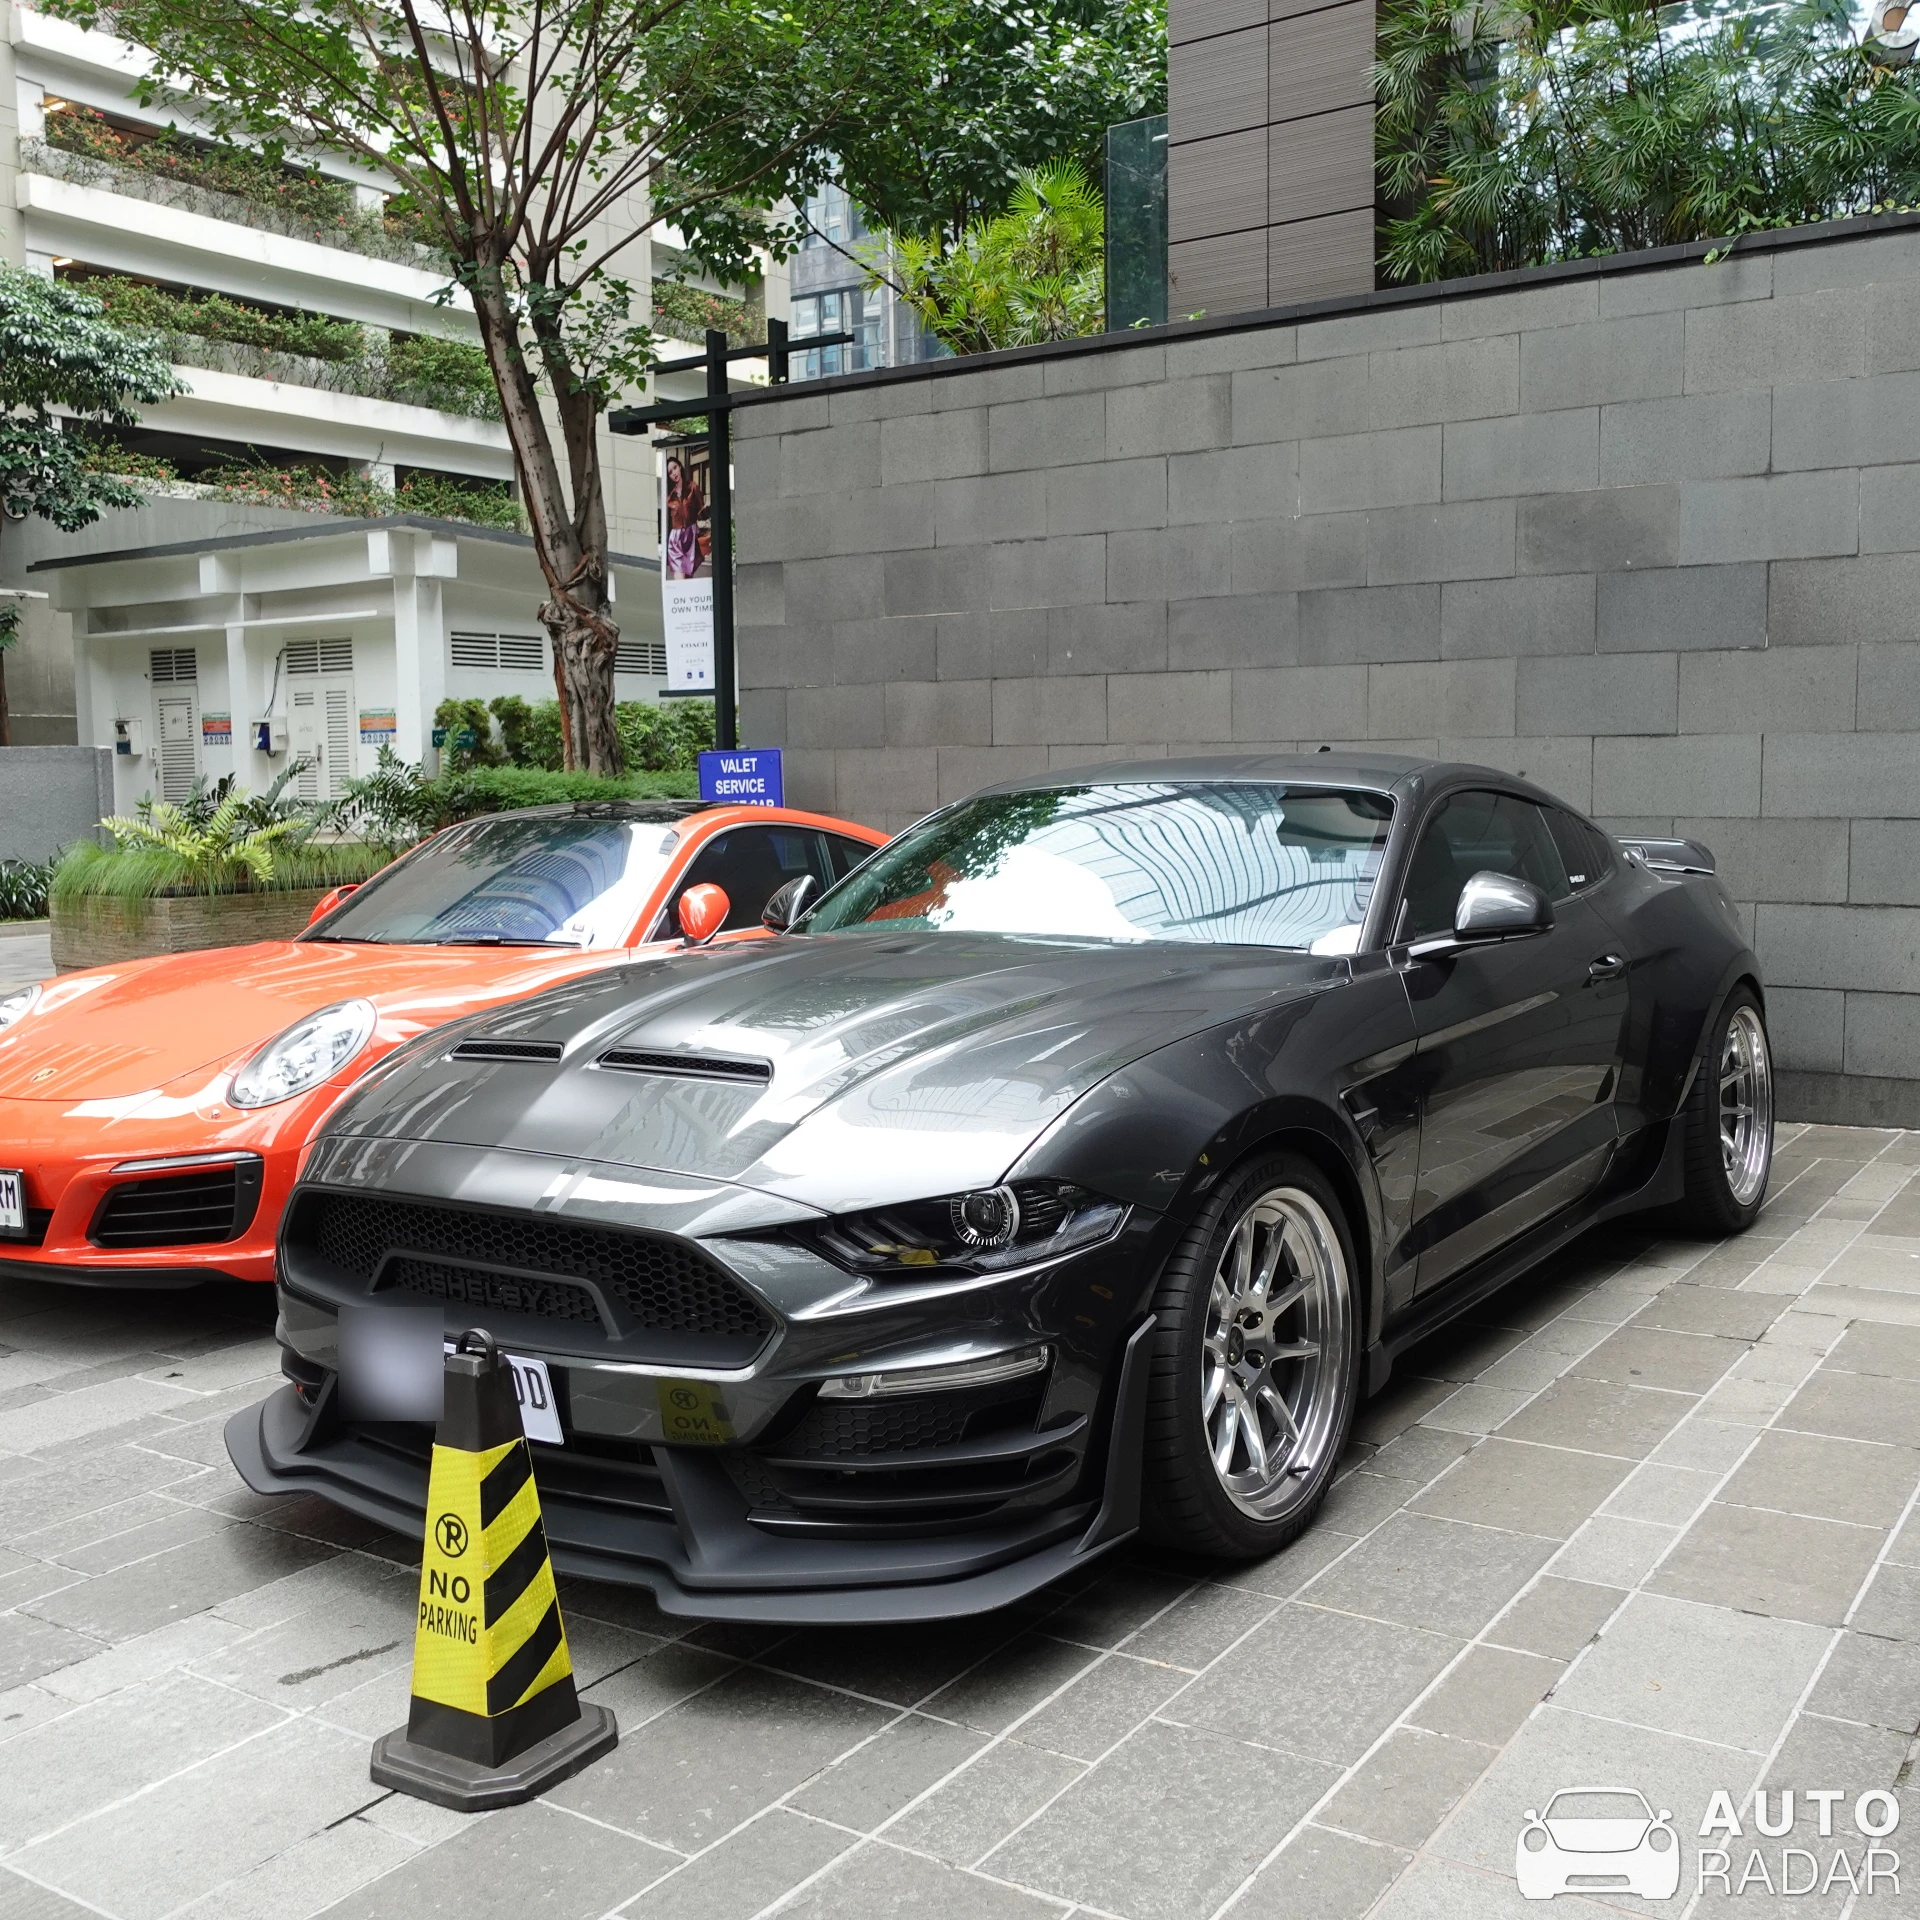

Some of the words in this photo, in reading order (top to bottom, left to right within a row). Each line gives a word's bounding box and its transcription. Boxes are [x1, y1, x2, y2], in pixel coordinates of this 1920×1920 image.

[673, 597, 686, 605] ON
[689, 595, 712, 604] YOUR
[671, 606, 691, 614] OWN
[695, 604, 713, 612] TIME
[720, 757, 758, 774] VALET
[715, 778, 766, 795] SERVICE
[430, 1271, 543, 1310] SHELBY
[429, 1568, 471, 1604] NO
[420, 1601, 478, 1645] PARKING
